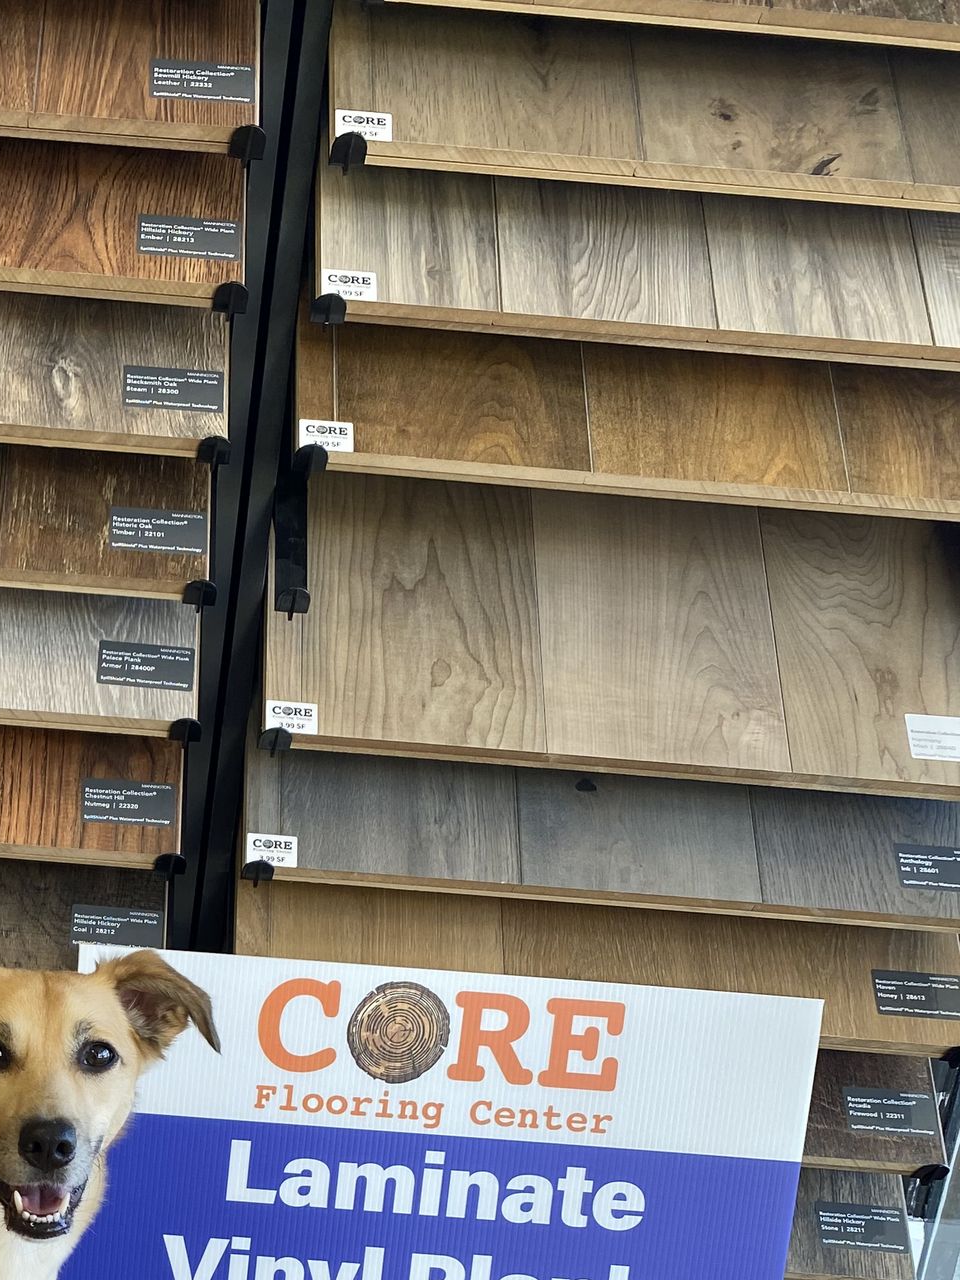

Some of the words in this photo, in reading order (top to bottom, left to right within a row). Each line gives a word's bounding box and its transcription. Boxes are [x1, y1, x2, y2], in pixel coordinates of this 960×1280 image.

[342, 115, 386, 126] CORE
[328, 274, 371, 285] CORE
[306, 425, 347, 435] CORE
[272, 706, 312, 717] CORE
[253, 839, 292, 850] CORE
[900, 858, 932, 866] Anthology
[97, 920, 120, 928] Hickory
[877, 992, 897, 1000] Honey
[257, 978, 626, 1092] CORE
[254, 1084, 445, 1129] Flooring
[469, 1100, 613, 1135] Center
[225, 1139, 646, 1231] Laminate
[843, 1218, 865, 1226] Hickory
